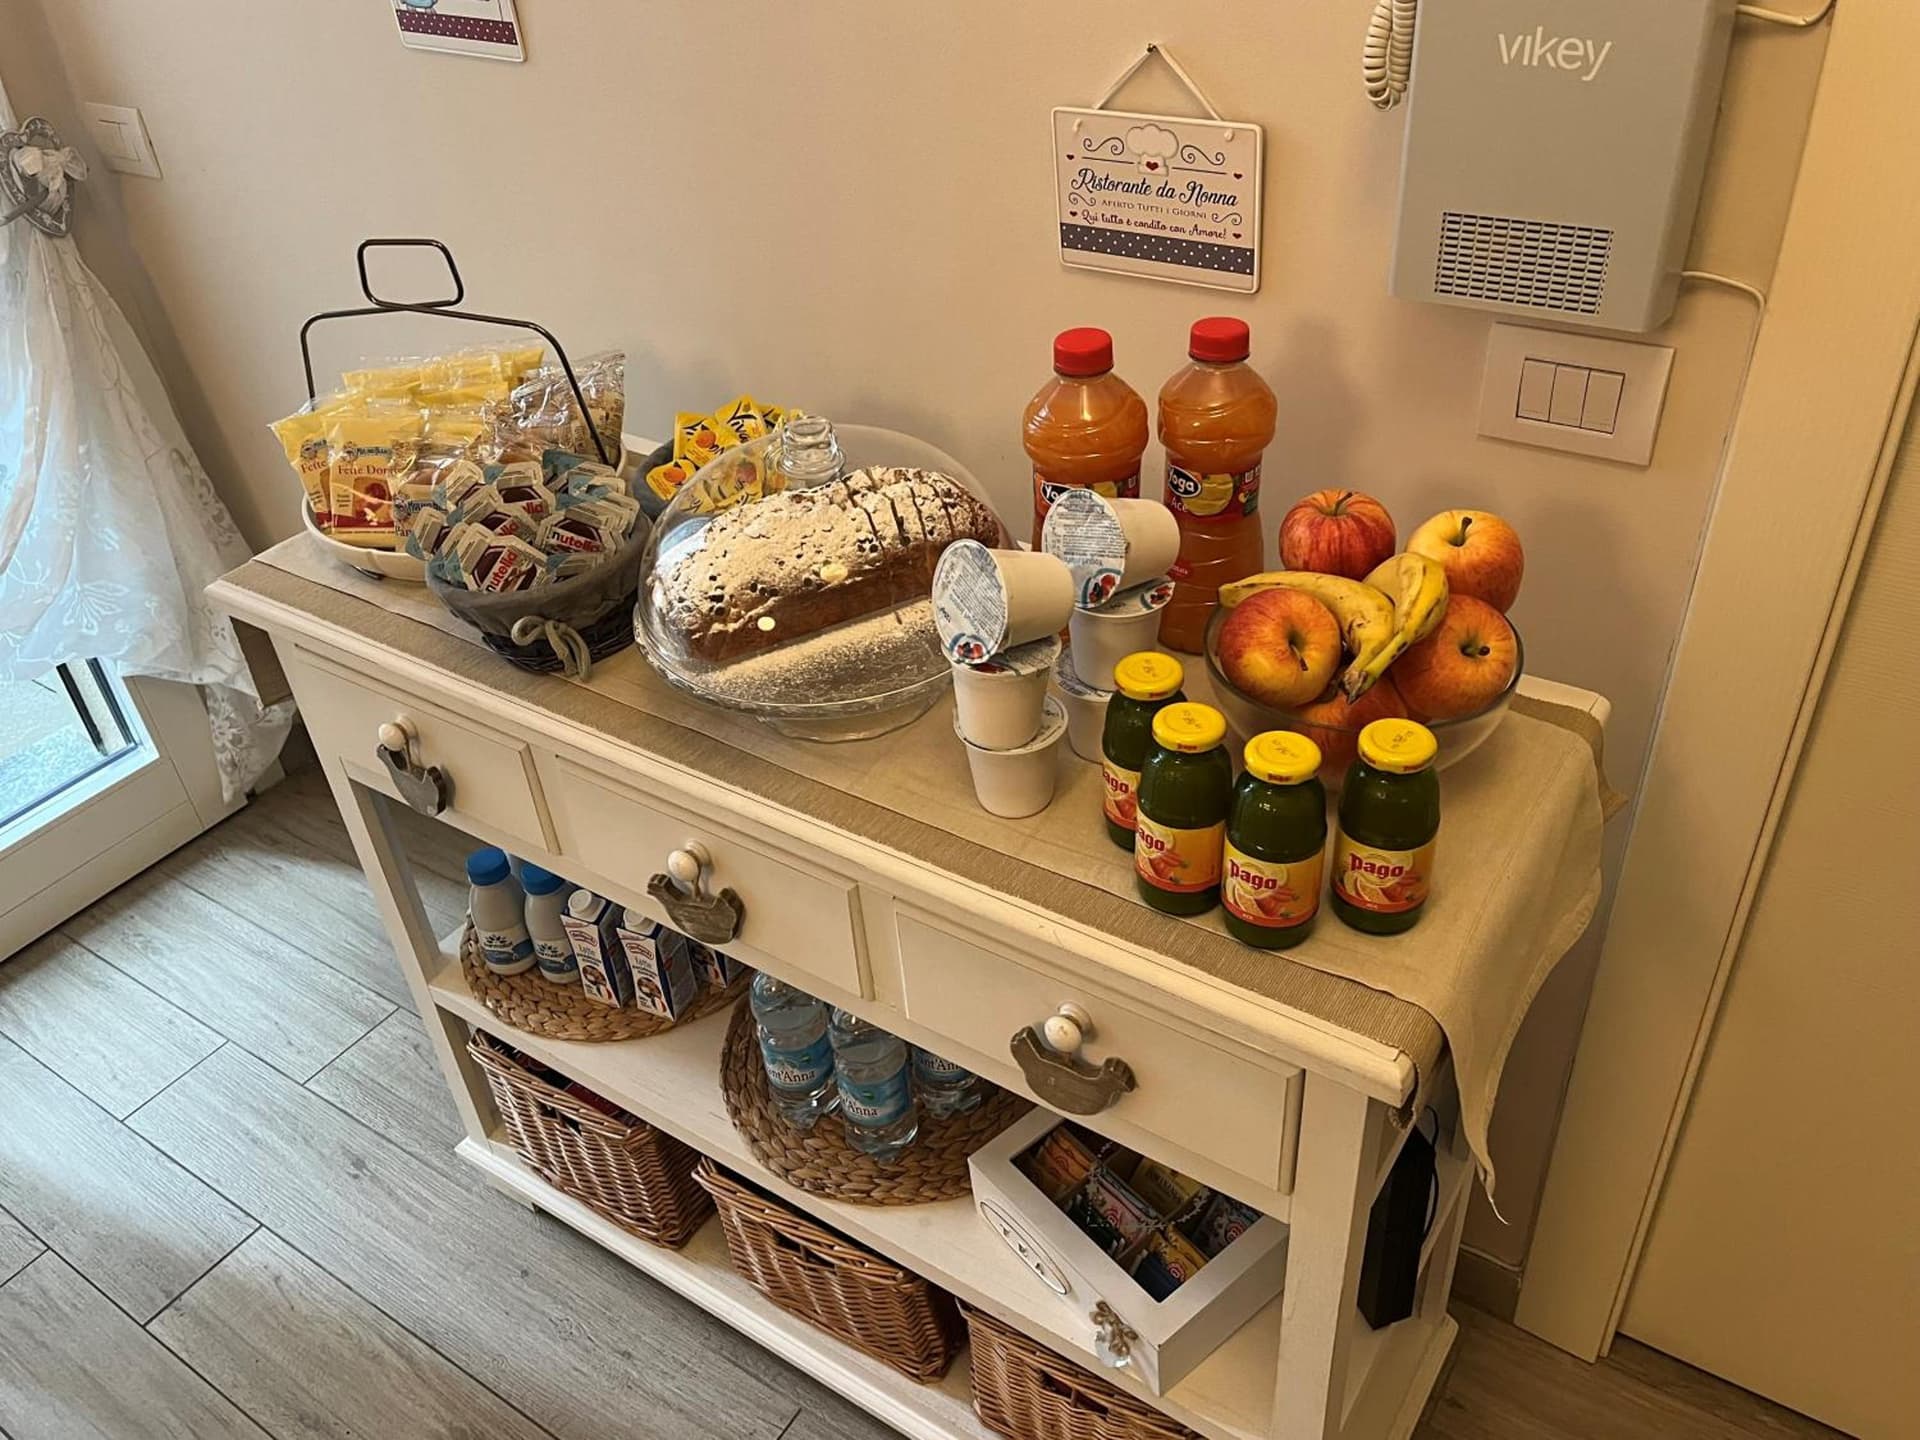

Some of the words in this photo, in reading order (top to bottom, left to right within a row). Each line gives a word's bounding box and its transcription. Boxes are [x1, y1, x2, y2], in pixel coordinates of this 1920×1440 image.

[1498, 25, 1613, 82] vikey
[1071, 168, 1152, 195] Ristorante
[1156, 180, 1176, 199] da
[1179, 181, 1238, 207] Nonna
[1081, 209, 1098, 225] Qui
[1101, 213, 1124, 225] tutto
[1134, 220, 1167, 231] condito
[1169, 225, 1186, 234] con
[1189, 223, 1227, 239] Amore!
[552, 531, 601, 553] nutella
[485, 551, 519, 593] nutella
[1103, 771, 1130, 794] ago
[1137, 827, 1166, 852] ago
[1229, 859, 1279, 891] pago
[1350, 853, 1404, 880] pago
